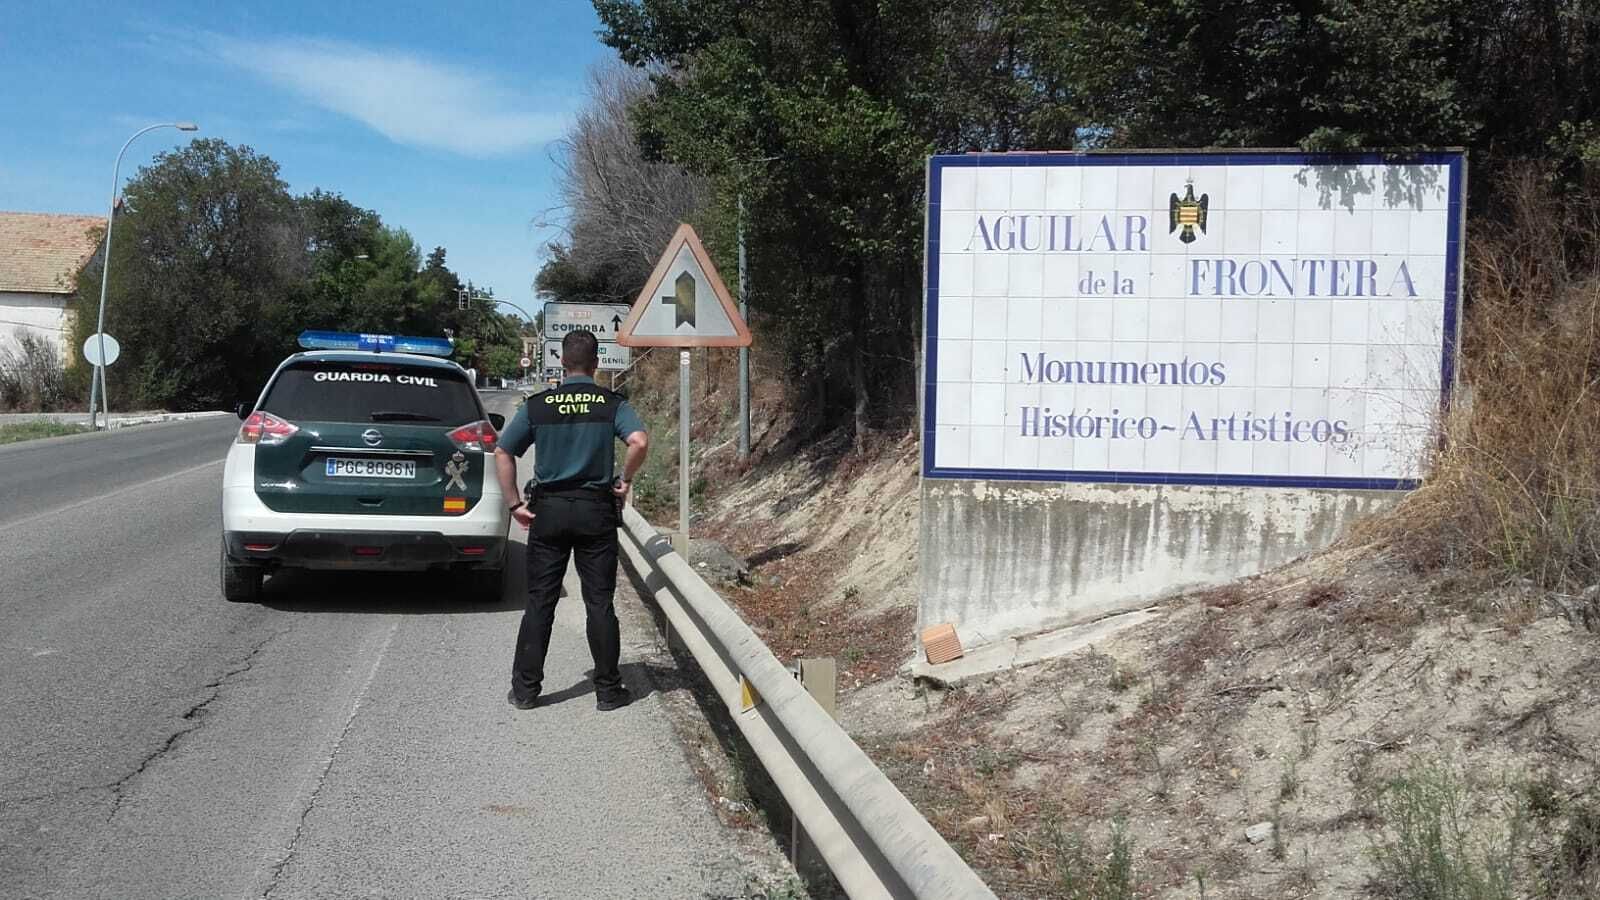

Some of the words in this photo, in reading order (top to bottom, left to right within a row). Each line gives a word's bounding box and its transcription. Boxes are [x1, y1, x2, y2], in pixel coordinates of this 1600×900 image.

[964, 214, 1151, 253] AGUILAR
[1078, 271, 1106, 295] de
[1112, 271, 1135, 295] la
[1188, 259, 1419, 298] FRONTERA
[552, 323, 606, 332] CORDOBA
[1019, 352, 1226, 386] Monumentos
[314, 372, 391, 383] GUARDIA
[396, 375, 438, 387] CIVIL
[545, 393, 605, 403] GUARDIA
[558, 404, 590, 414] CIVIL
[335, 460, 363, 474] PGC
[366, 461, 403, 476] 8096
[404, 463, 415, 476] N
